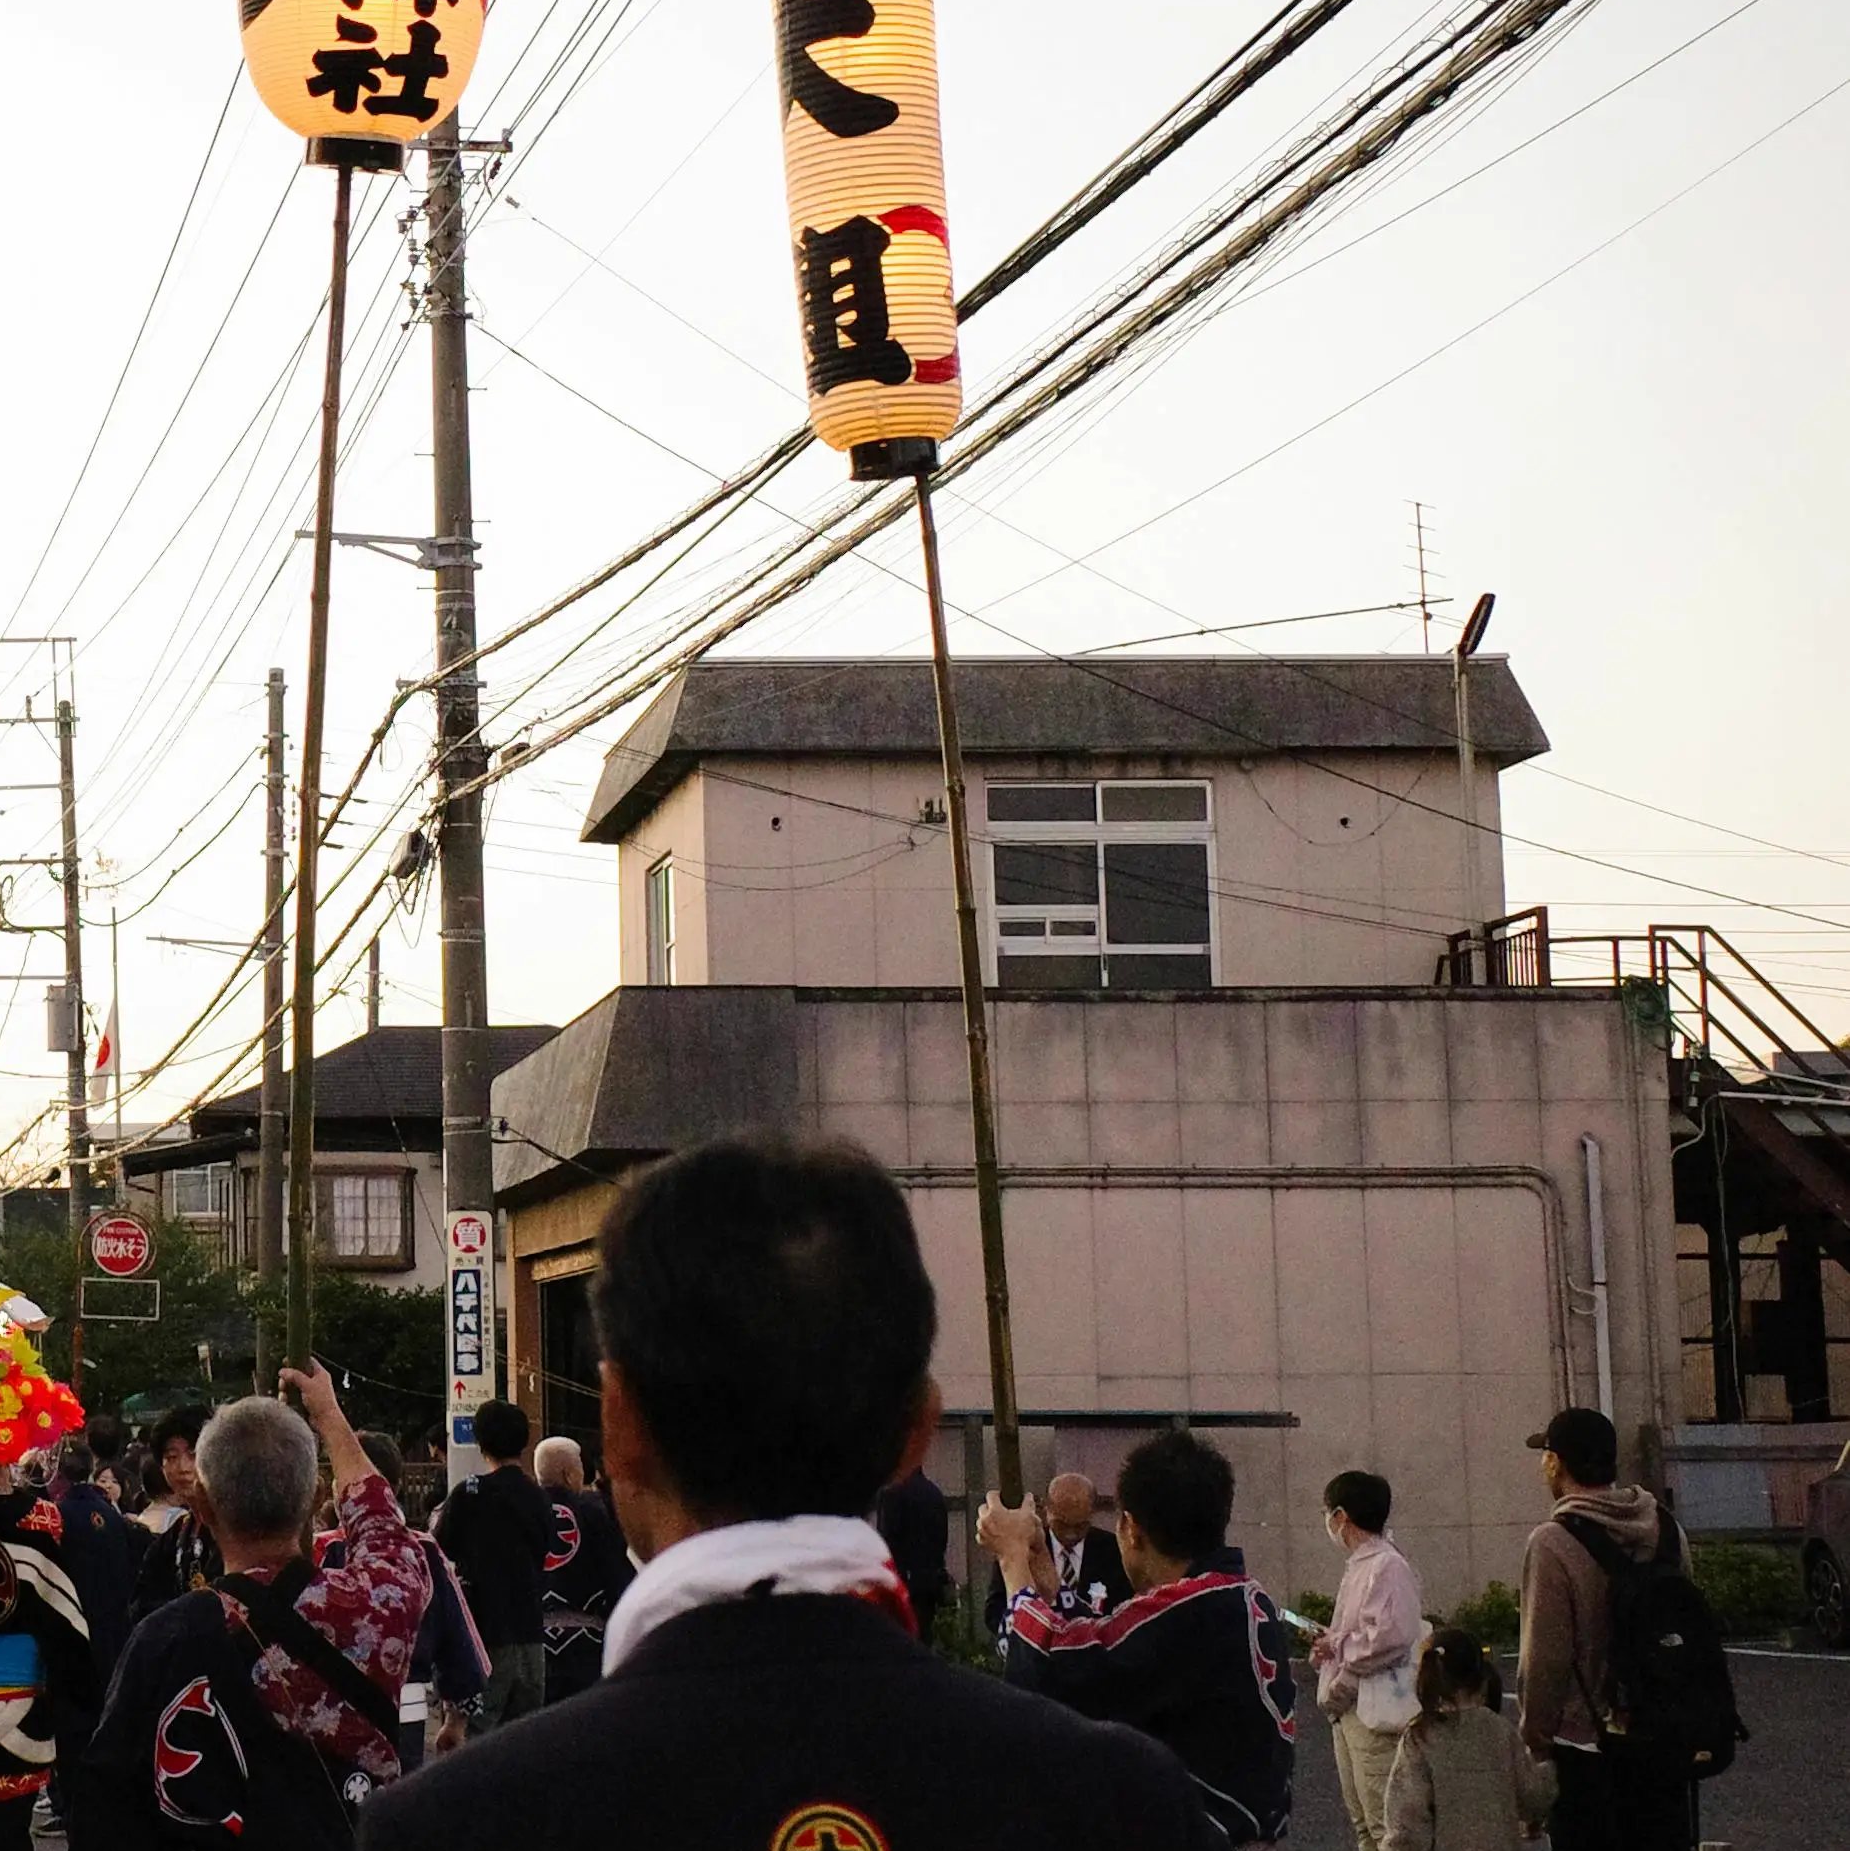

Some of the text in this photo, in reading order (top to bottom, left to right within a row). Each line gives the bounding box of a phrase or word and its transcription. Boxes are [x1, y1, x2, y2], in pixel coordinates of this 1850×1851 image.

[96, 1237, 145, 1259] 防火水そう
[454, 1219, 484, 1252] 質
[454, 1272, 480, 1372] 八千代商事
